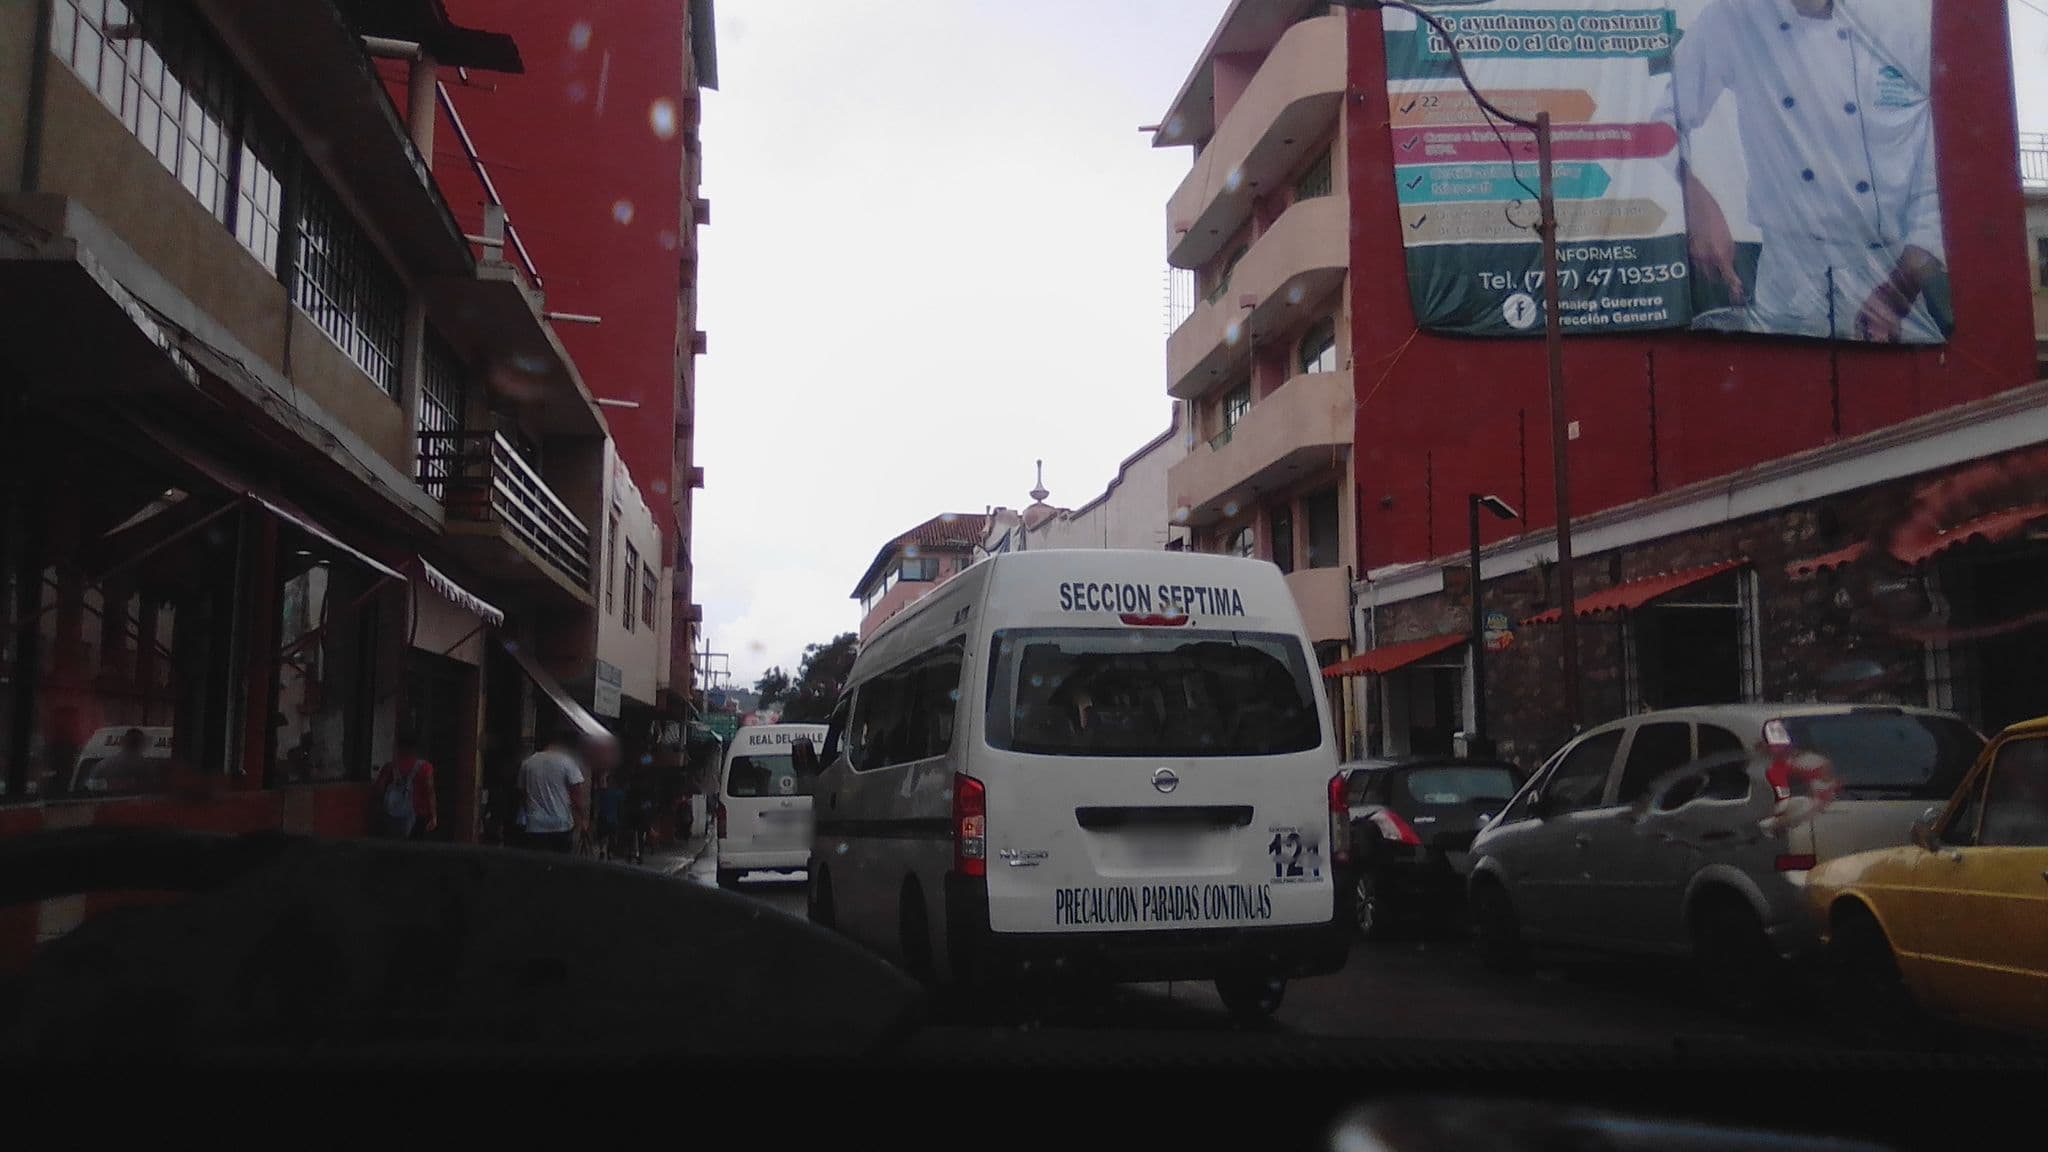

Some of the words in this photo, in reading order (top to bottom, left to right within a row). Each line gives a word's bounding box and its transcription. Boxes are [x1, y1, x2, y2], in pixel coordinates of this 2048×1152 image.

[1462, 15, 1556, 33] ayudamos
[1562, 17, 1574, 31] a
[1579, 15, 1661, 32] construir
[1507, 36, 1519, 50] o
[1525, 33, 1541, 50] el
[1550, 34, 1568, 50] de
[1576, 34, 1593, 50] tu
[1600, 33, 1672, 51] empres
[1422, 96, 1438, 108] 22
[1555, 245, 1637, 262] NFORMES:
[1478, 270, 1517, 290] Tel.
[1524, 268, 1579, 292] (77)
[1586, 268, 1612, 286] 47
[1617, 261, 1686, 285] 19330
[1601, 295, 1663, 309] Guerrero
[1613, 308, 1668, 323] General
[1060, 582, 1150, 613] SECCION
[1158, 584, 1245, 617] SEPTIMA
[749, 734, 774, 746] REAL
[776, 733, 791, 745] DEL
[1055, 887, 1139, 925] PRECAUCION
[1142, 885, 1200, 922] PARADAS
[1203, 883, 1272, 920] CONTINUAS
